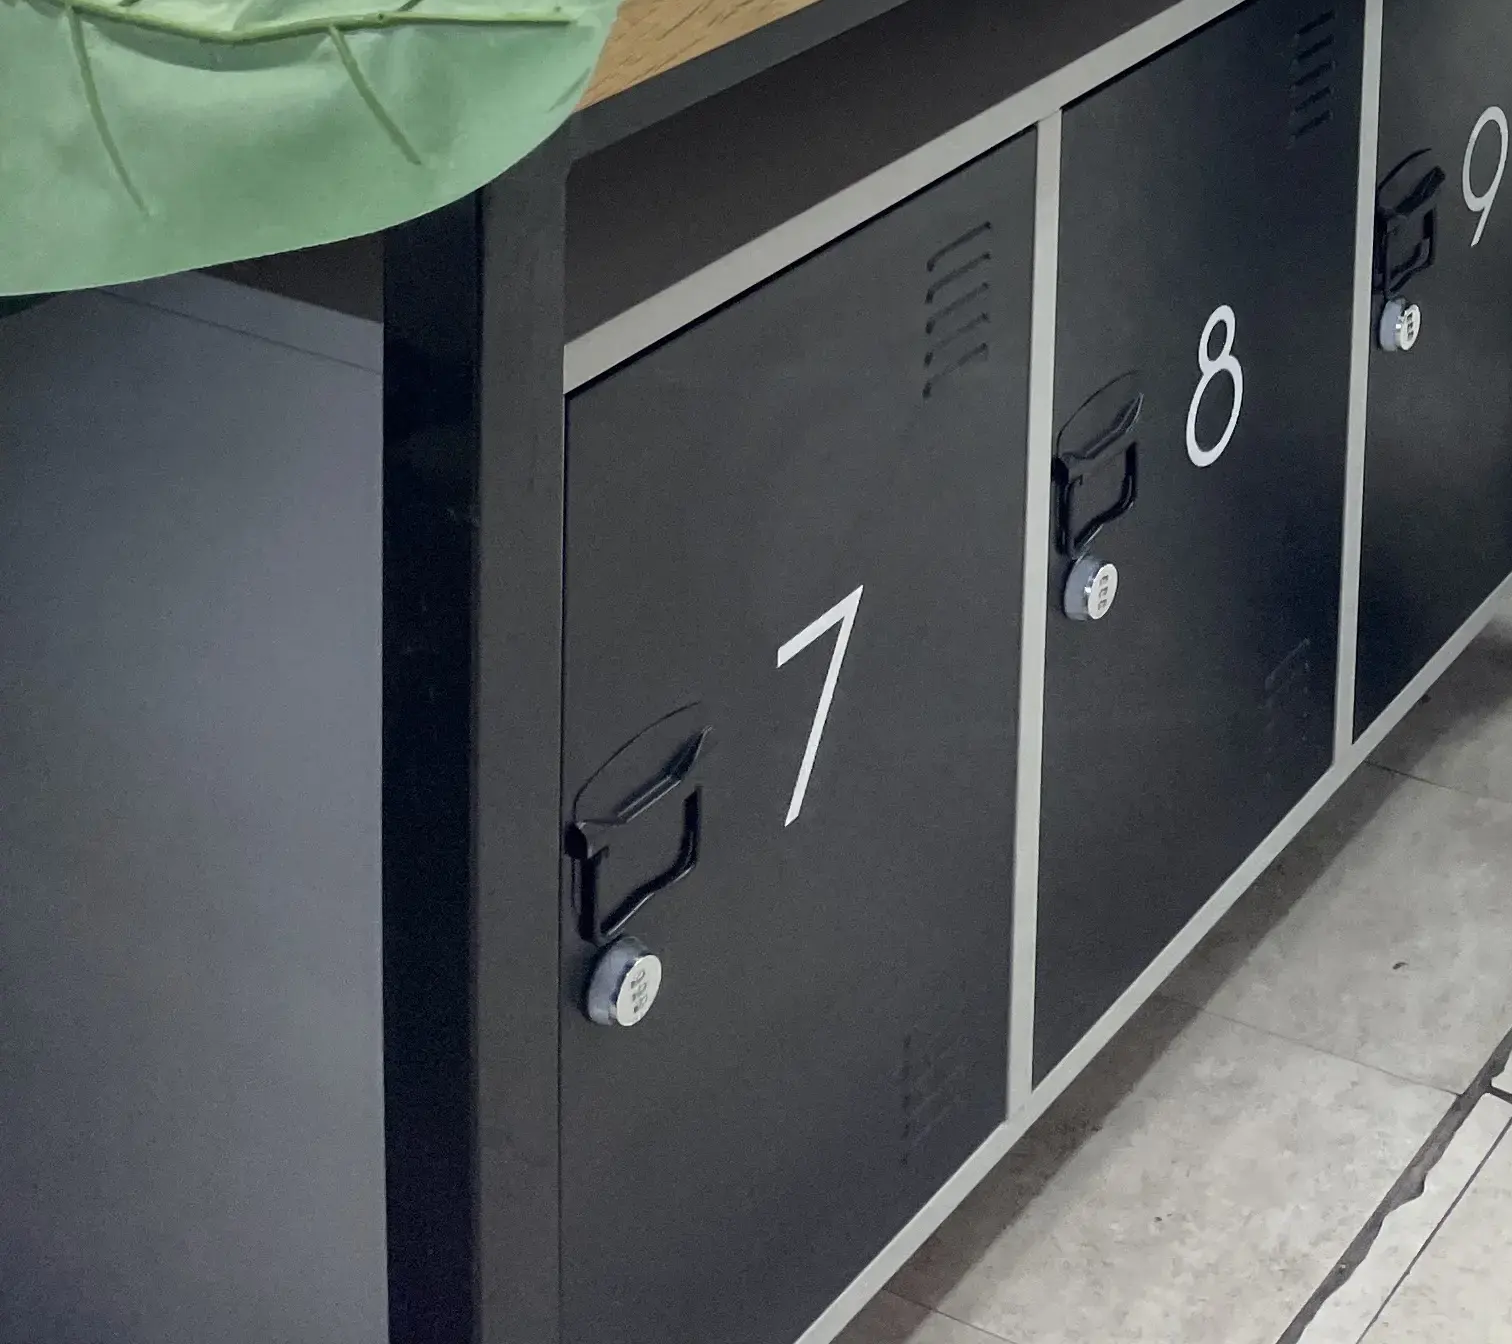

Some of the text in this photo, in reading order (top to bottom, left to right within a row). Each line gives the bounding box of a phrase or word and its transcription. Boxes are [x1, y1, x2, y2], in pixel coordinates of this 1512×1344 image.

[1462, 106, 1509, 247] 9
[1186, 304, 1243, 467] 8
[777, 584, 864, 828] 7
